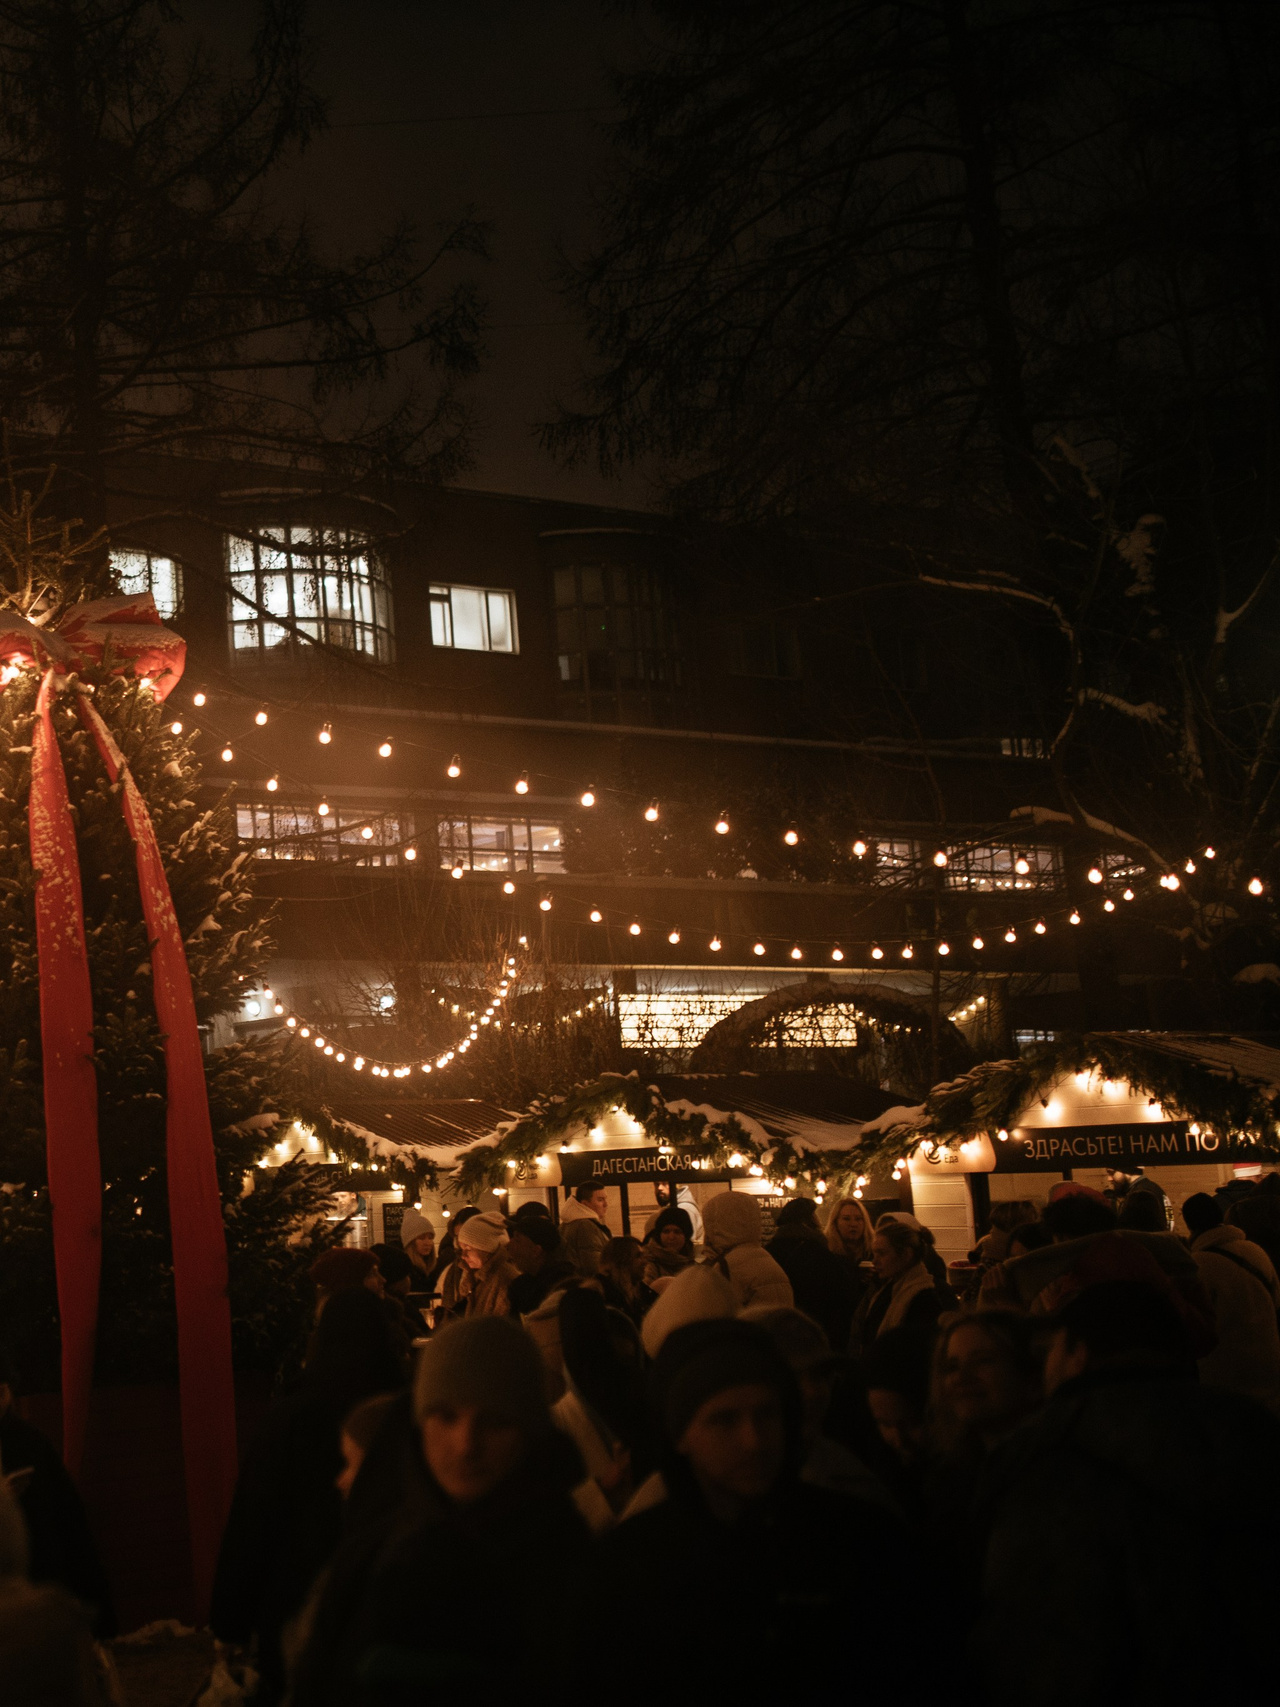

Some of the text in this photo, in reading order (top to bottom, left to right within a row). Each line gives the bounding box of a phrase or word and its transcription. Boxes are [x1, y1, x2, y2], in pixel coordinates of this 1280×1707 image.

[1024, 1136, 1123, 1160] ЗДРАСЬТЕ!
[1130, 1134, 1179, 1154] НАМ
[592, 1154, 692, 1176] ДАГЕСТАНСКАЯ
